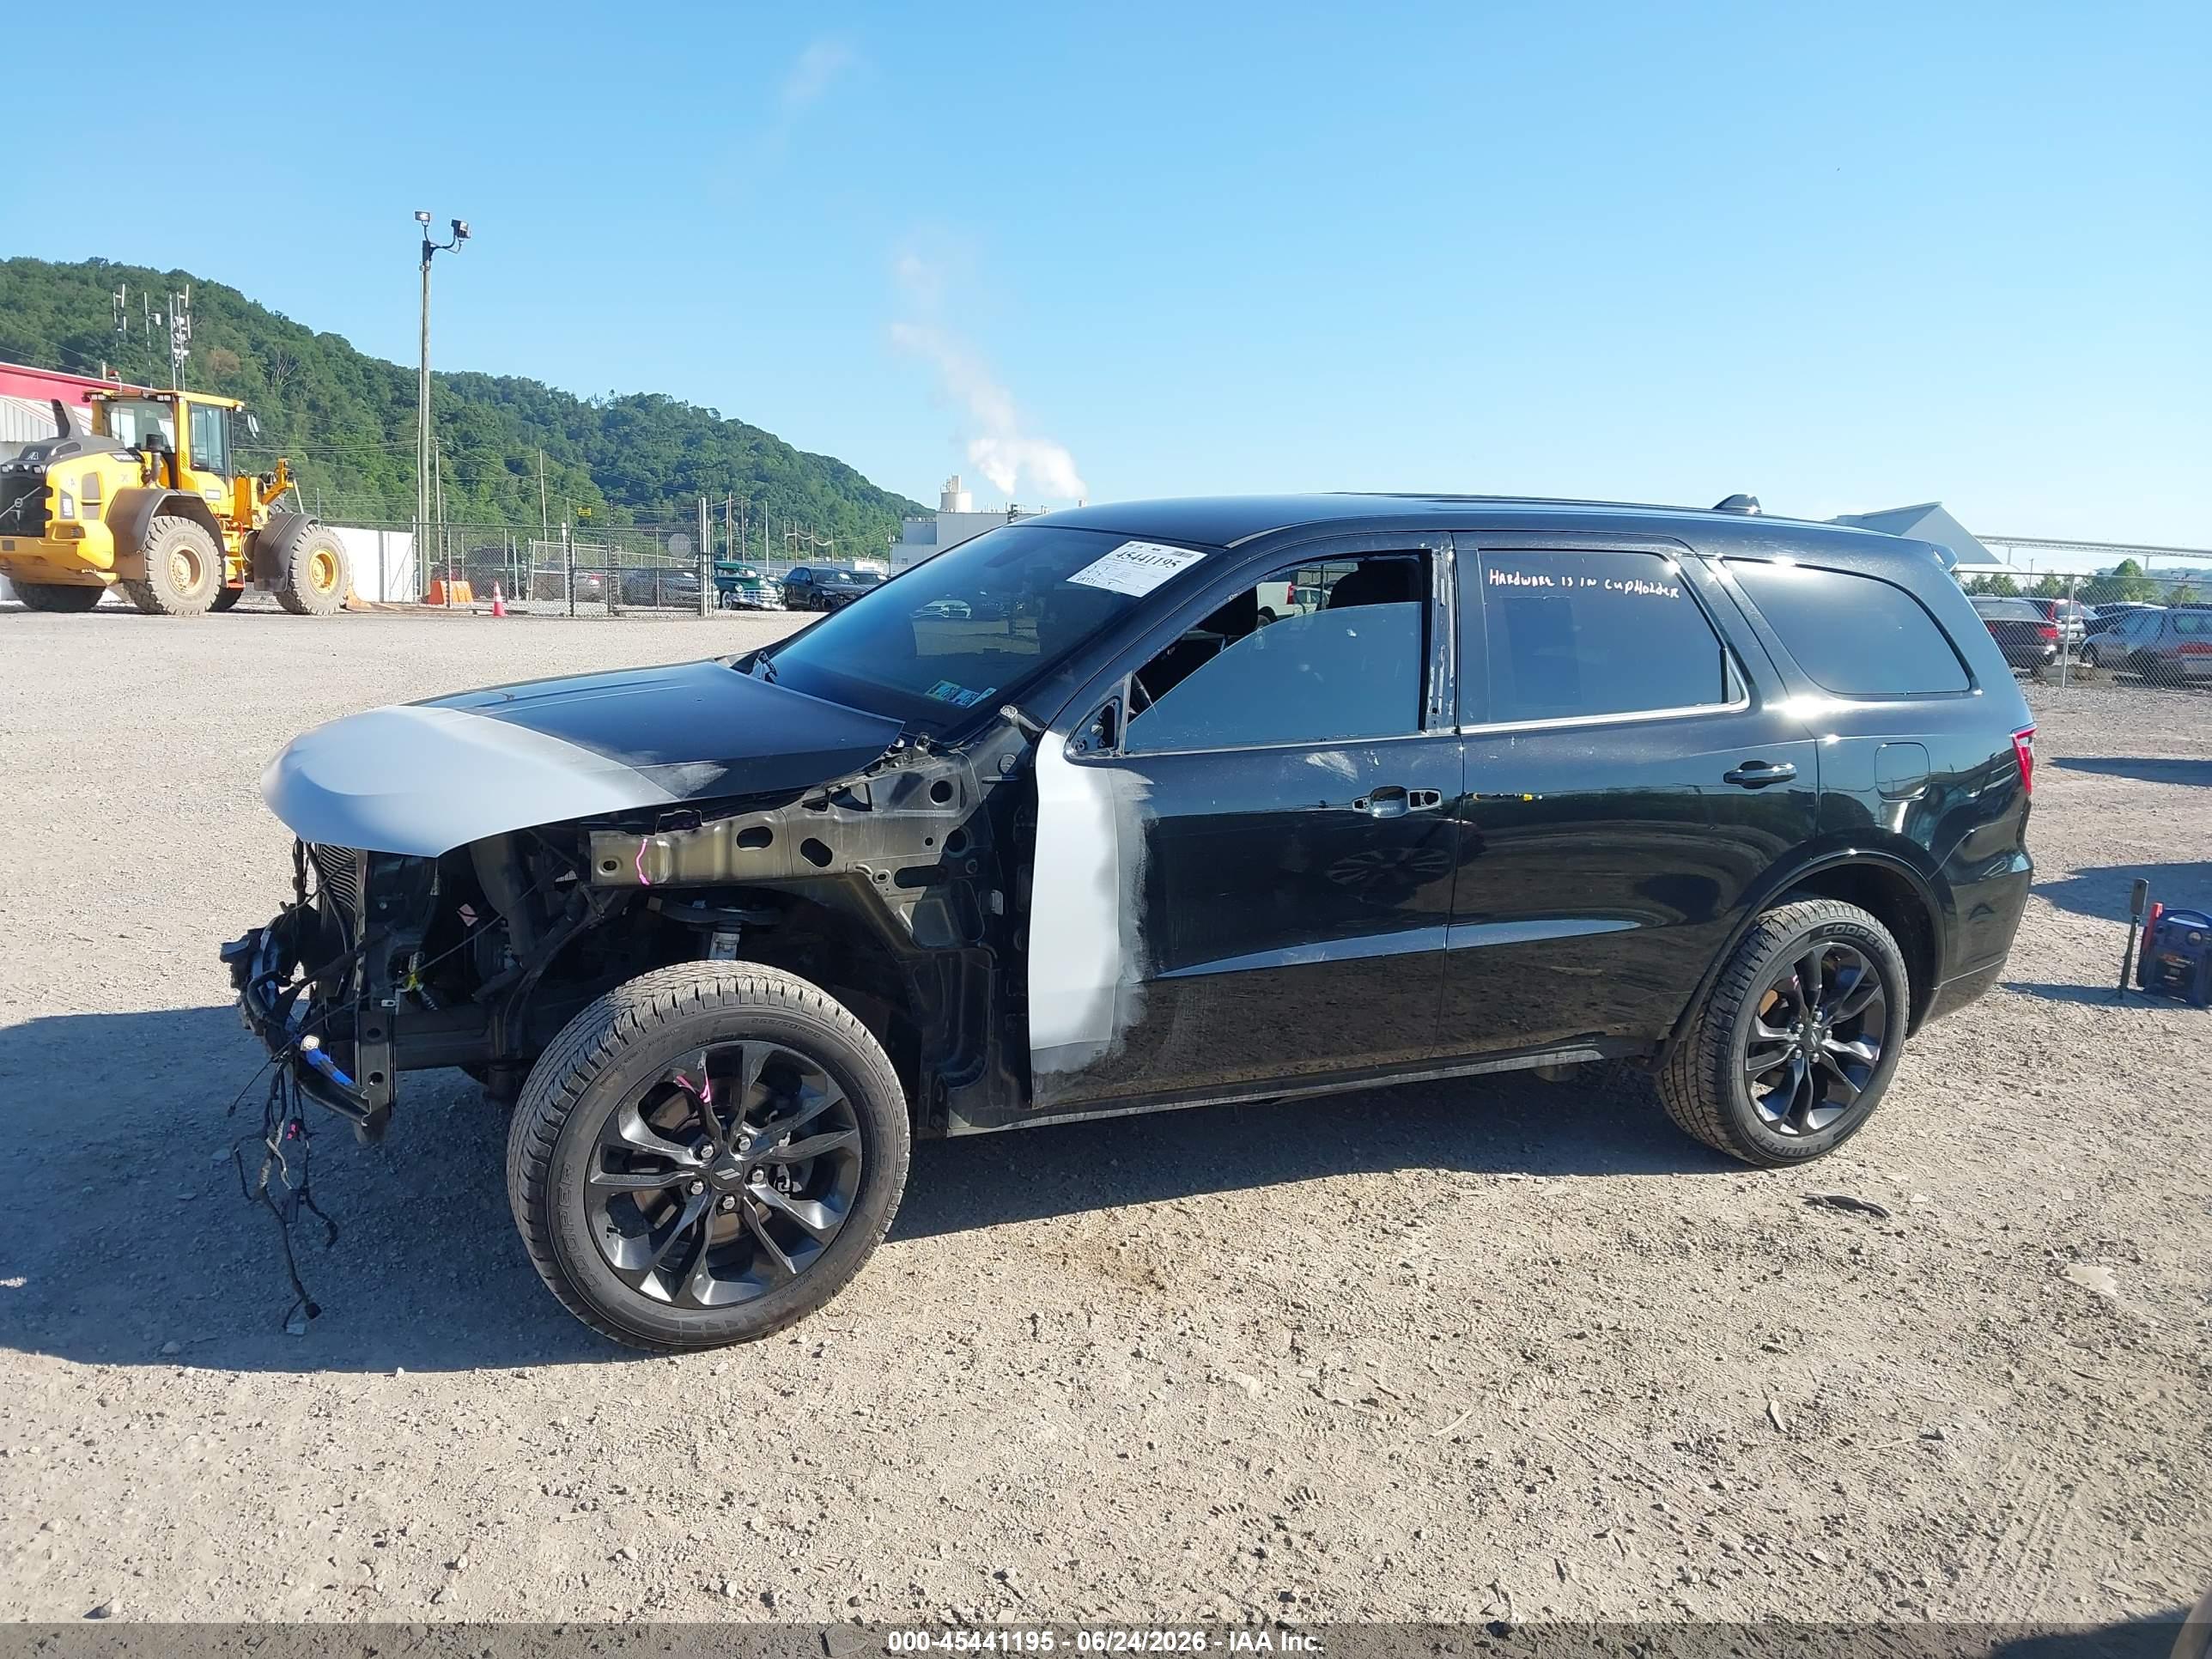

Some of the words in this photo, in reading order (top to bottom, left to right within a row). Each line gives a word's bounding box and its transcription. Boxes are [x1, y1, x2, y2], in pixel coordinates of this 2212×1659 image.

[670, 541, 691, 550] STOP
[1115, 550, 1182, 568] 45441195
[1822, 924, 1887, 953] COOPER
[860, 1070, 891, 1190] COOPER
[559, 1161, 601, 1290] COOPER
